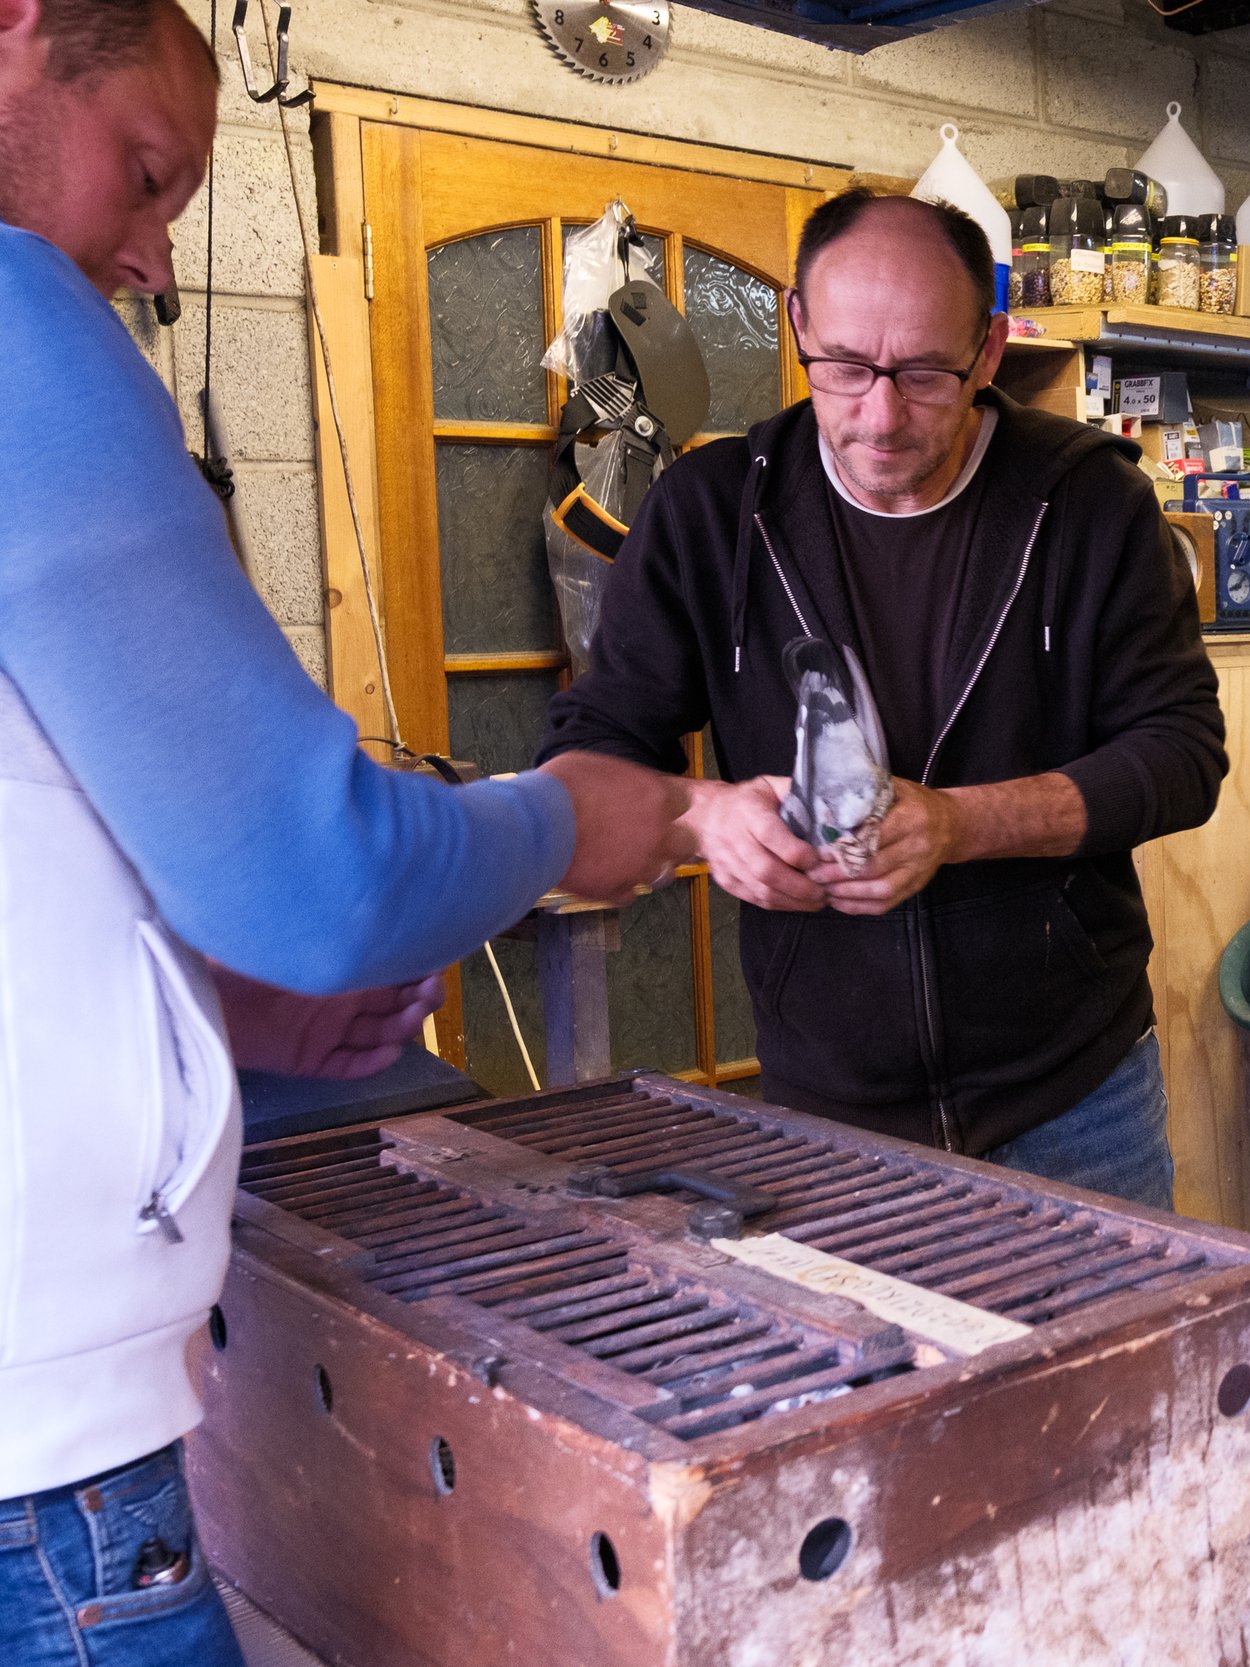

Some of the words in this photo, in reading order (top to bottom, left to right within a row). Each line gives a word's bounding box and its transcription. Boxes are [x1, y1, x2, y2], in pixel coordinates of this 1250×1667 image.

[554, 9, 564, 26] 8
[651, 10, 661, 26] 3
[574, 37, 584, 53] 7
[642, 34, 653, 50] 4
[598, 52, 609, 67] 6
[625, 51, 636, 67] 5
[1143, 394, 1156, 404] 50
